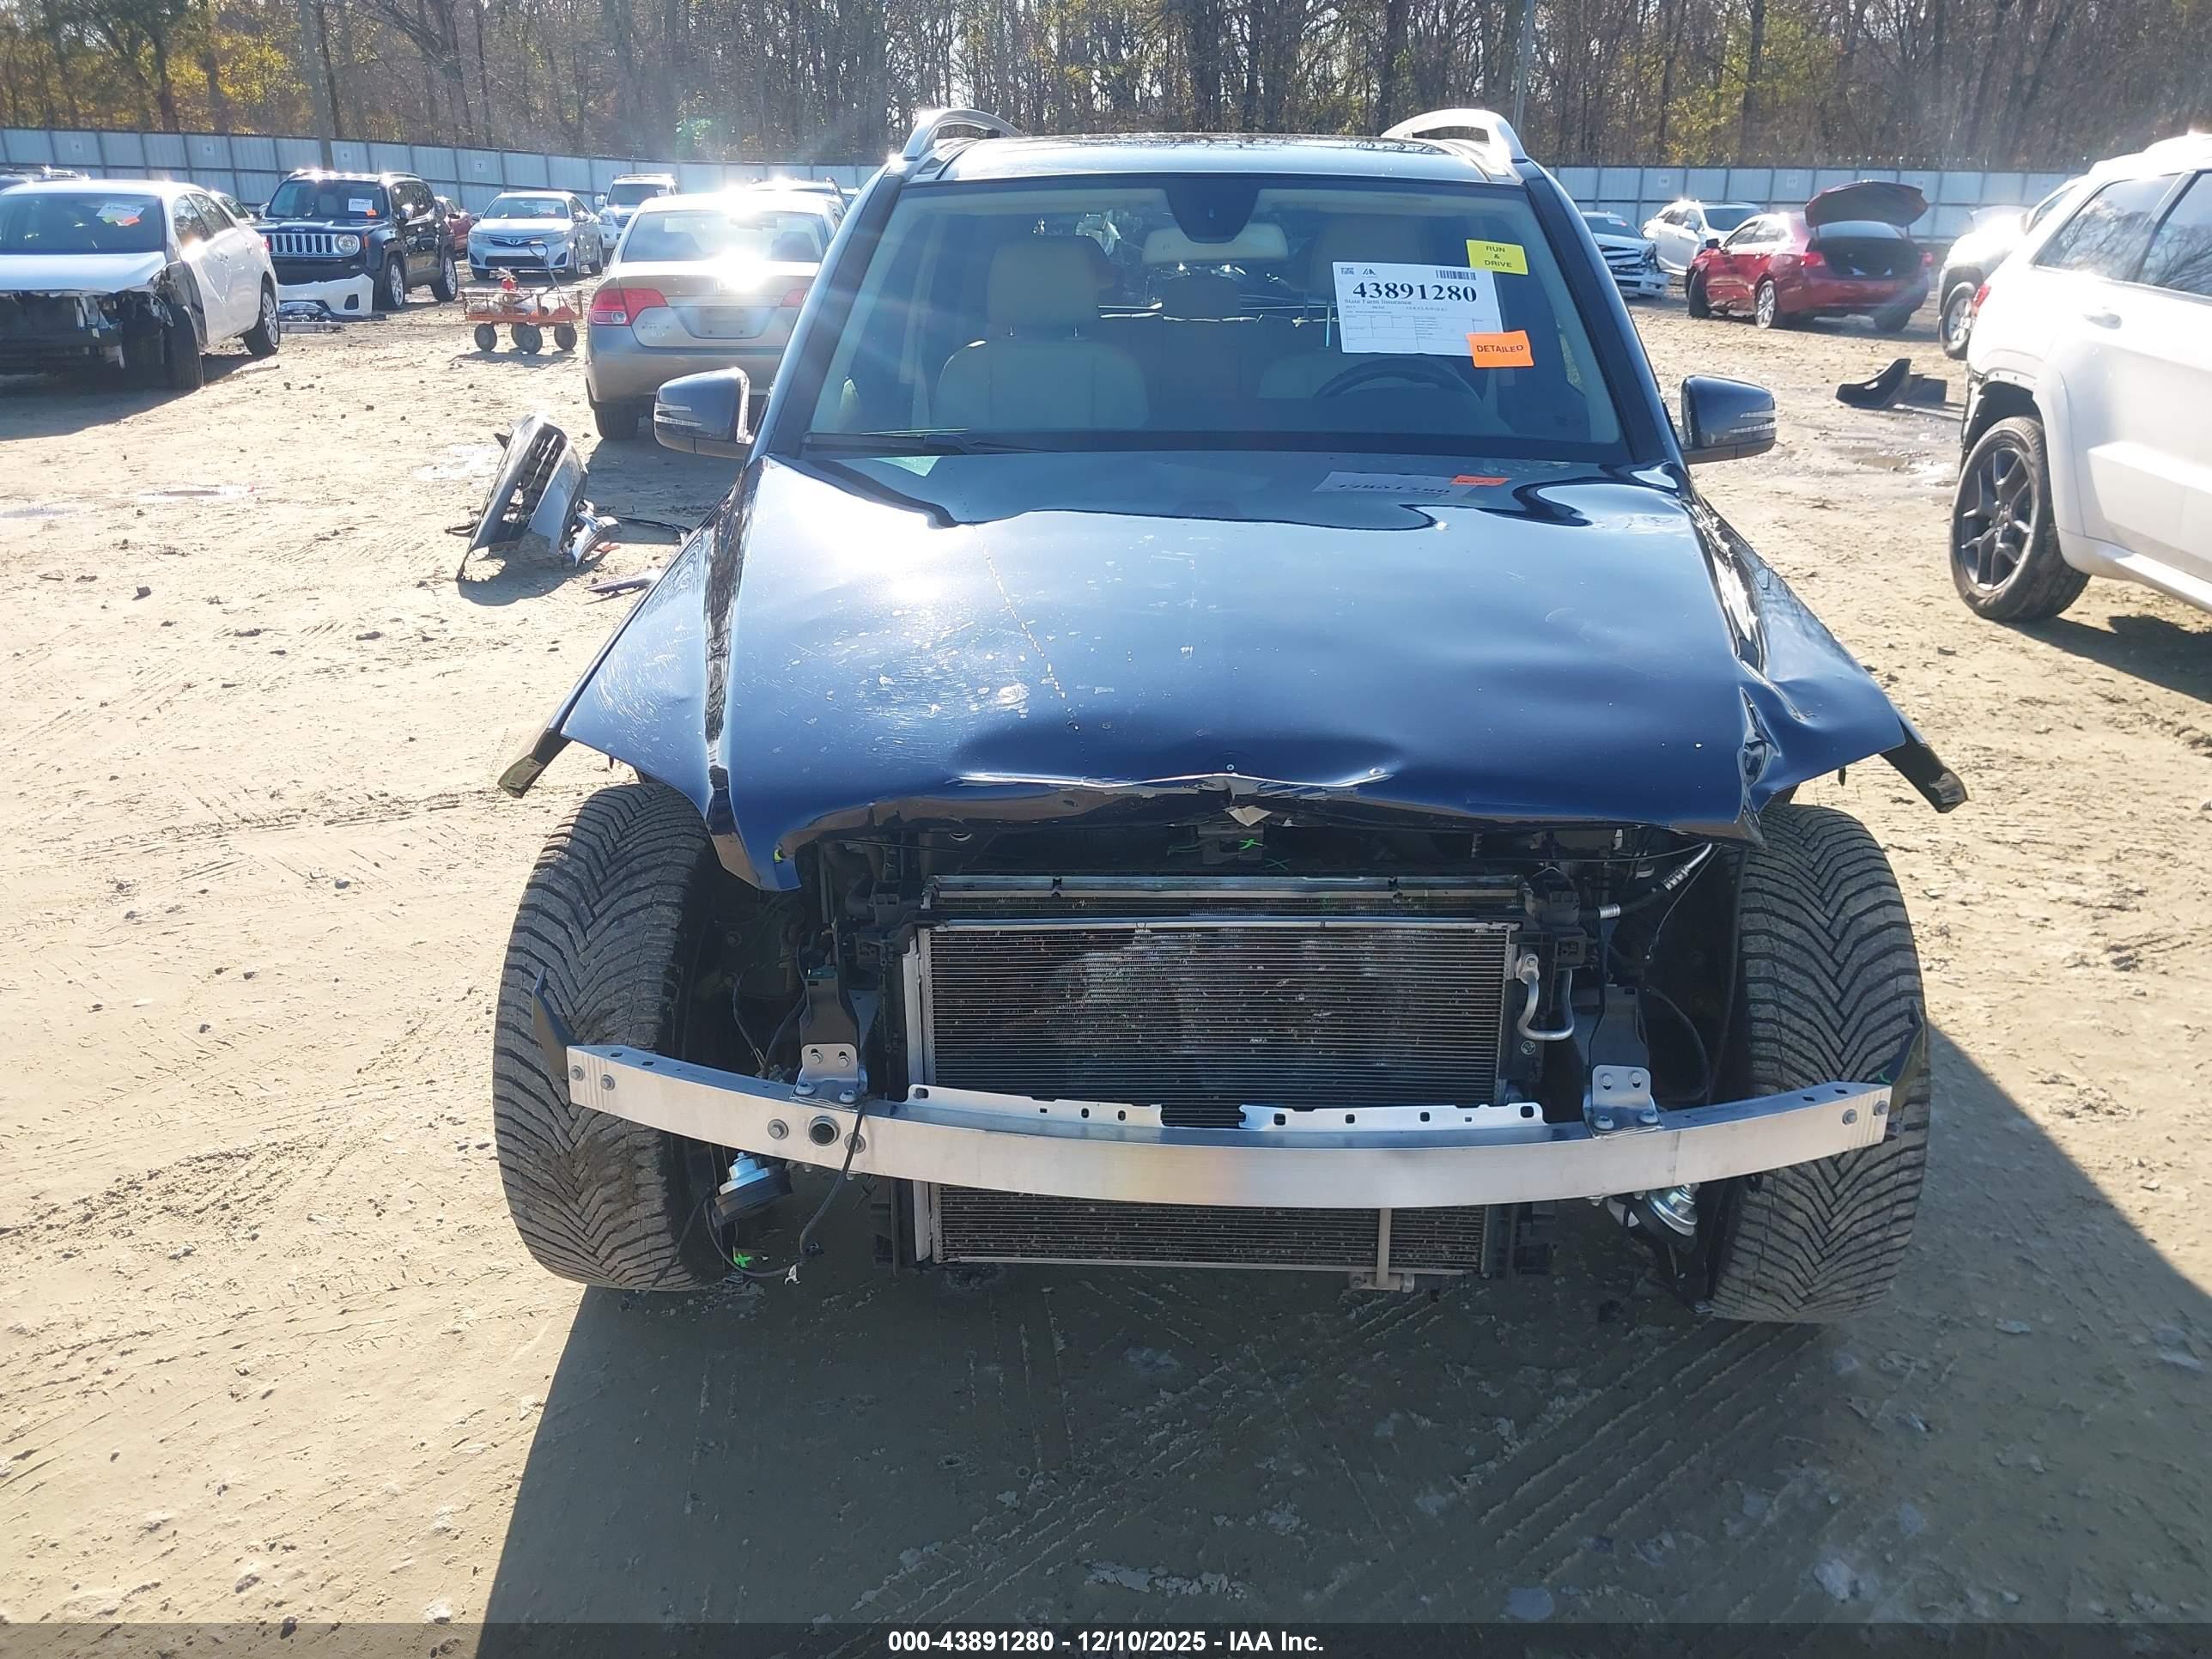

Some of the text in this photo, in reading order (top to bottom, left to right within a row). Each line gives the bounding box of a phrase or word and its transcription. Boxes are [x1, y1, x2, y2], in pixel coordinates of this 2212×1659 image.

[1484, 259, 1512, 268] DRIVE
[1352, 282, 1477, 302] 43891280
[1476, 344, 1524, 353] DETAILED
